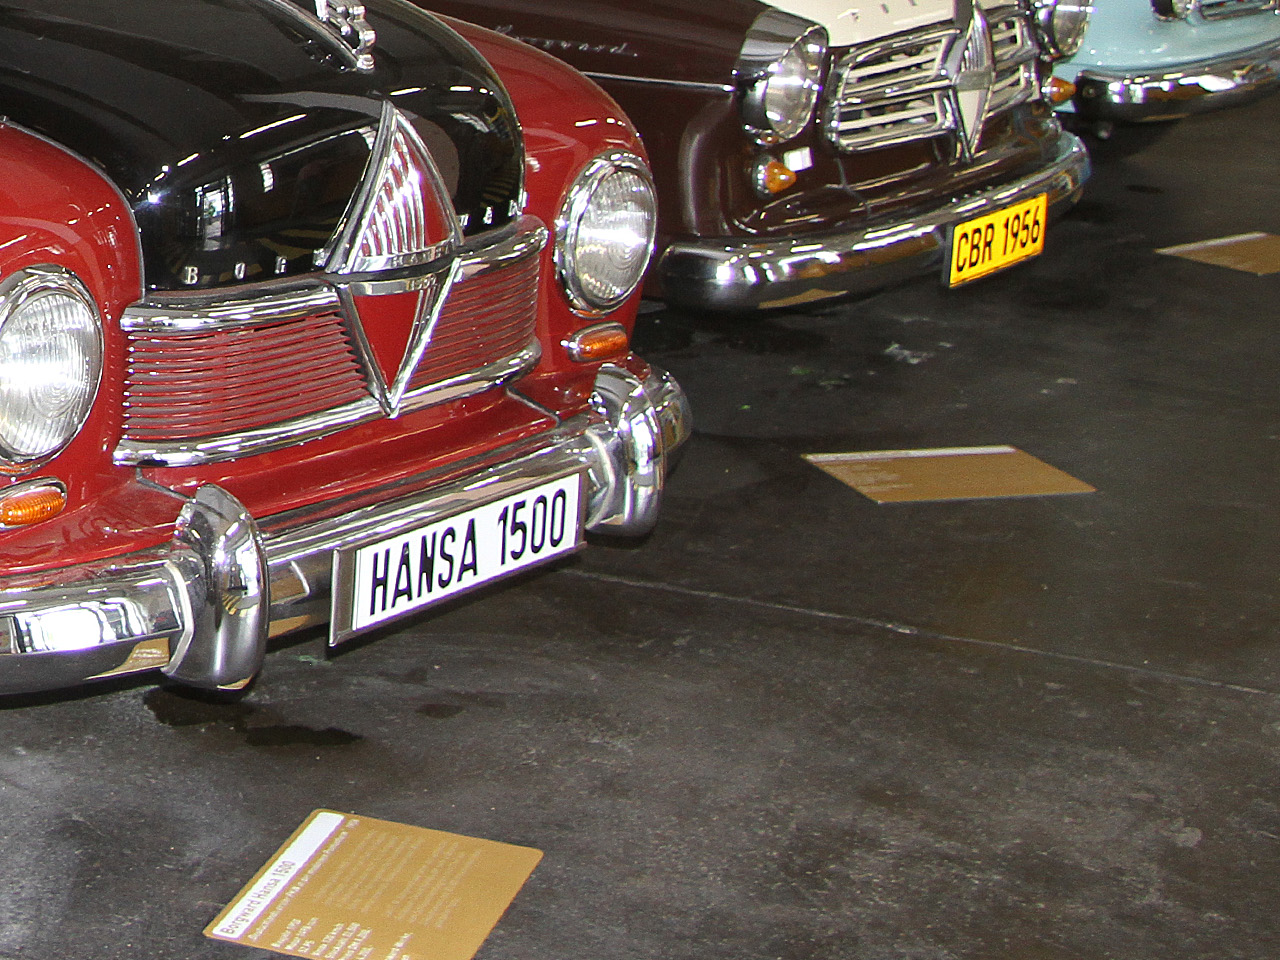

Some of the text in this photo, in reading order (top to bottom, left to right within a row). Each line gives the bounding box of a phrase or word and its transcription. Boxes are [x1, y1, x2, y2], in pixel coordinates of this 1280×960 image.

[956, 205, 1040, 272] CBR 1956
[370, 488, 566, 616] HANSA 1500
[220, 899, 261, 935] Borgward
[252, 878, 281, 900] Hansa
